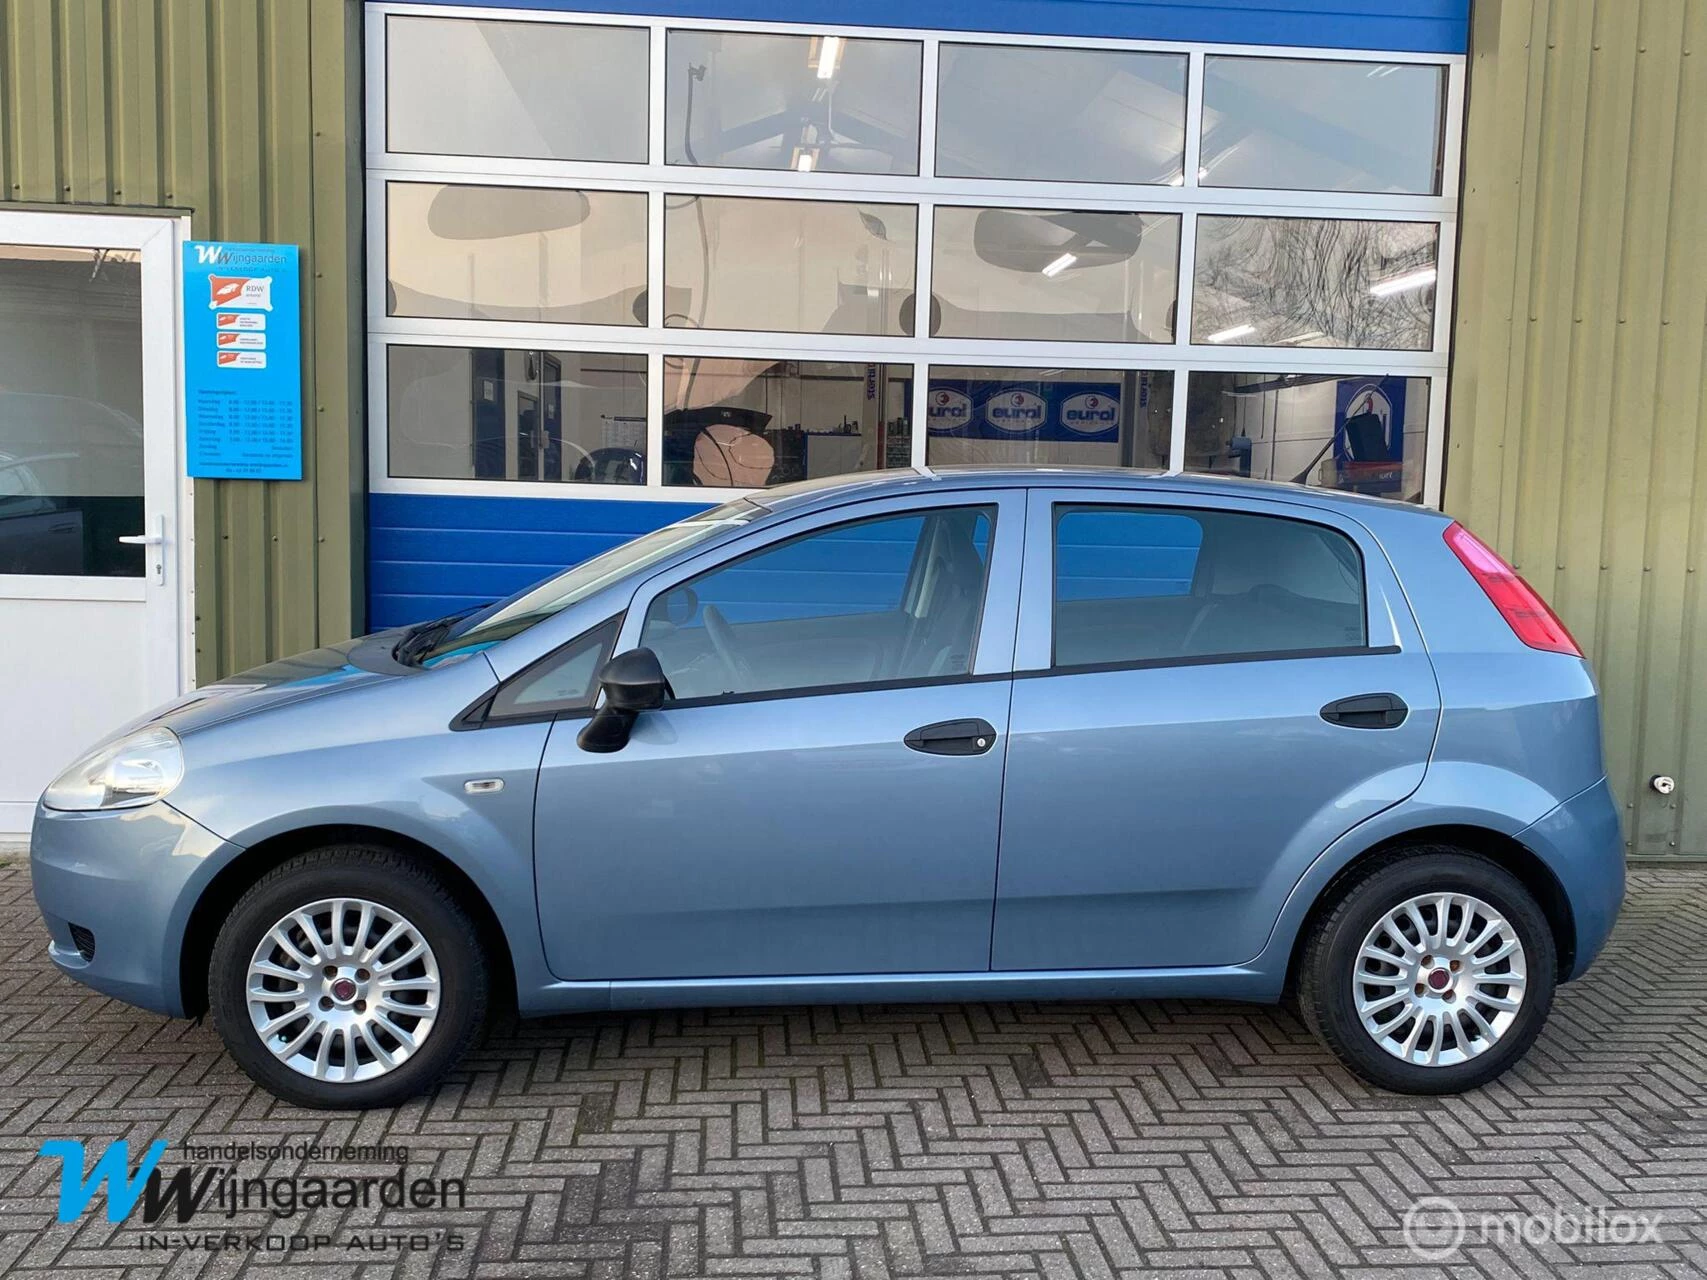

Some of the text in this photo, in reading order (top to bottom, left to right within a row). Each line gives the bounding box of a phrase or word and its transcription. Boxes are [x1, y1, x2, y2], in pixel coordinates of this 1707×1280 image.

[929, 403, 967, 418] urol
[992, 405, 1042, 420] eurol
[1066, 407, 1116, 422] eurol
